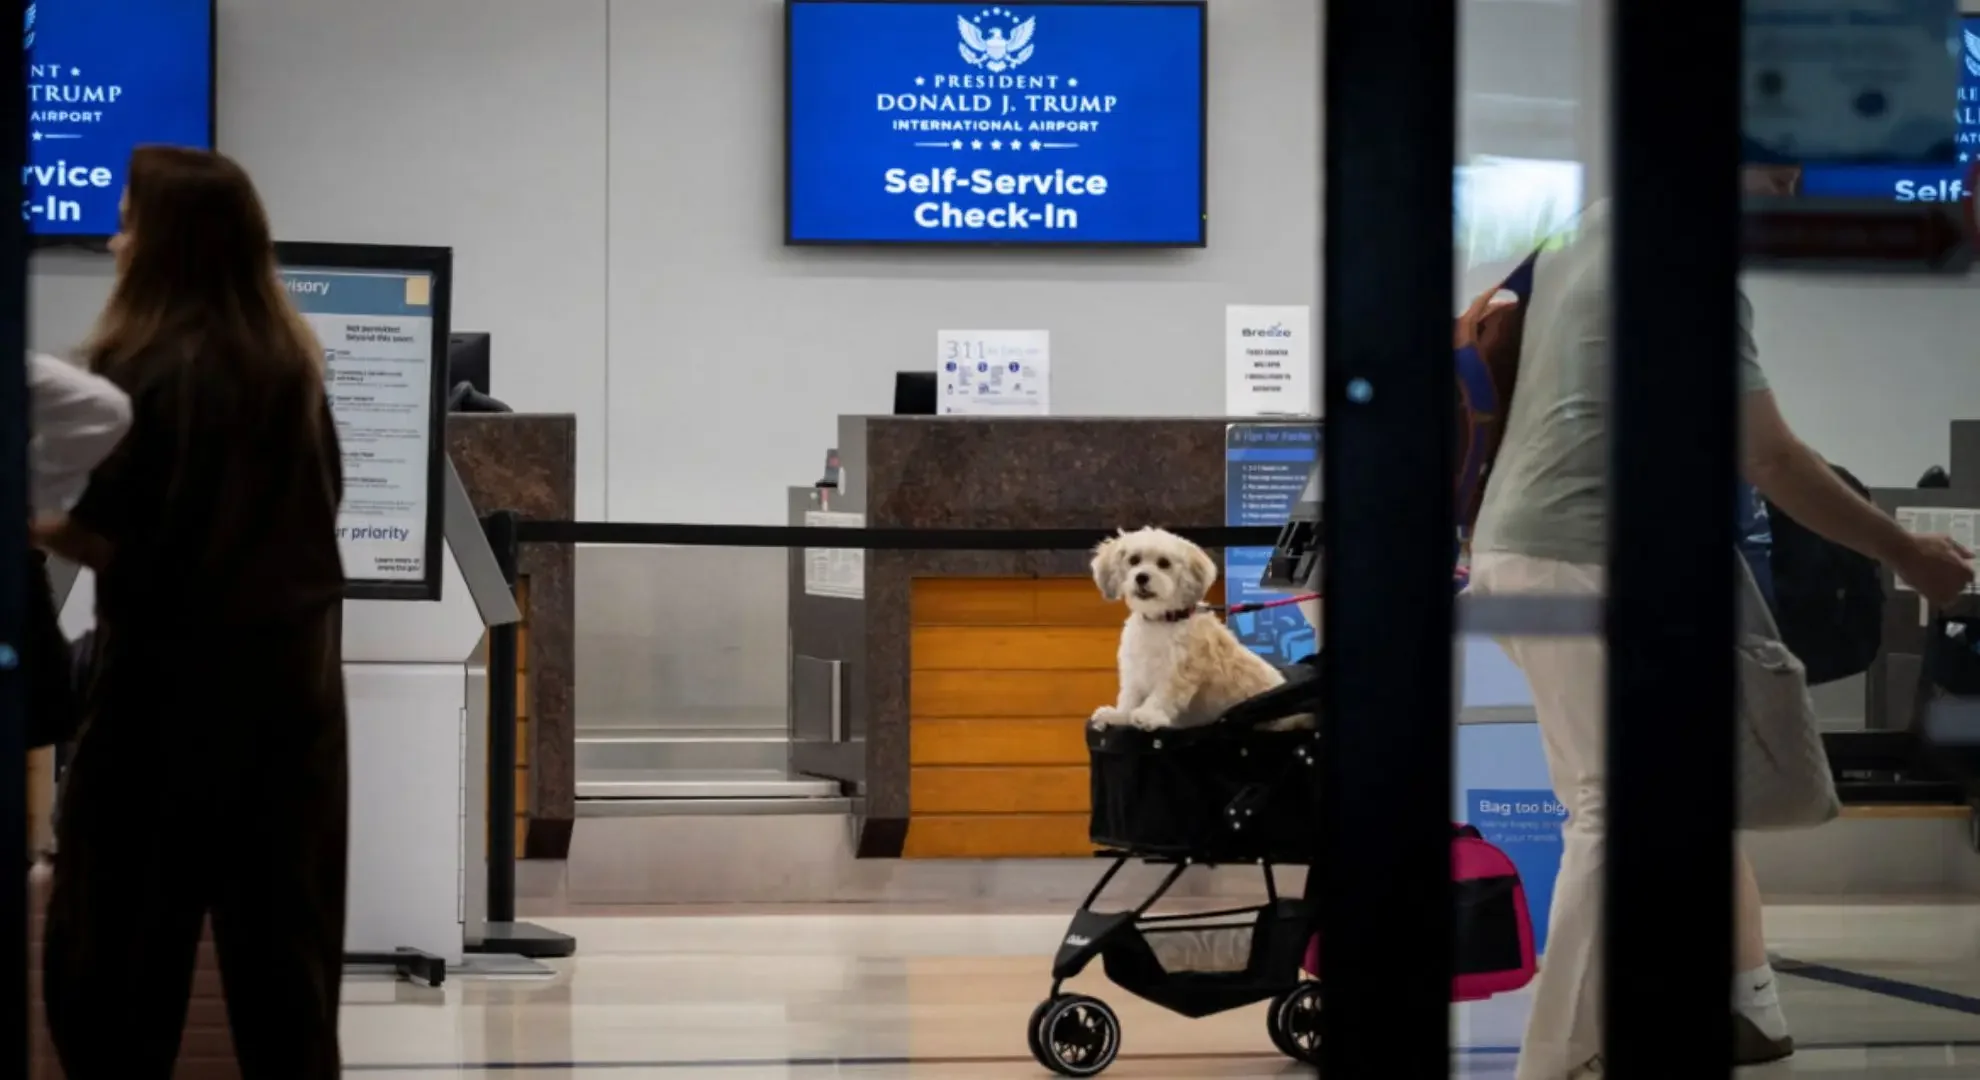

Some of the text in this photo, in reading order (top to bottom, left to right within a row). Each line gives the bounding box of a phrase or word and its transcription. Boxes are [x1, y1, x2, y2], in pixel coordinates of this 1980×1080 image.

[934, 75, 1058, 89] PRESIDENT
[28, 85, 122, 103] TRUMP
[877, 94, 1117, 115] DONALD J. TRUMP
[31, 111, 103, 122] AIRPORT
[893, 119, 1099, 132] INTERNATIONAL AIRPORT
[884, 168, 1108, 195] Self-Service
[914, 202, 1078, 228] Check-In
[352, 525, 410, 541] priority
[1480, 800, 1566, 816] Bag too big
